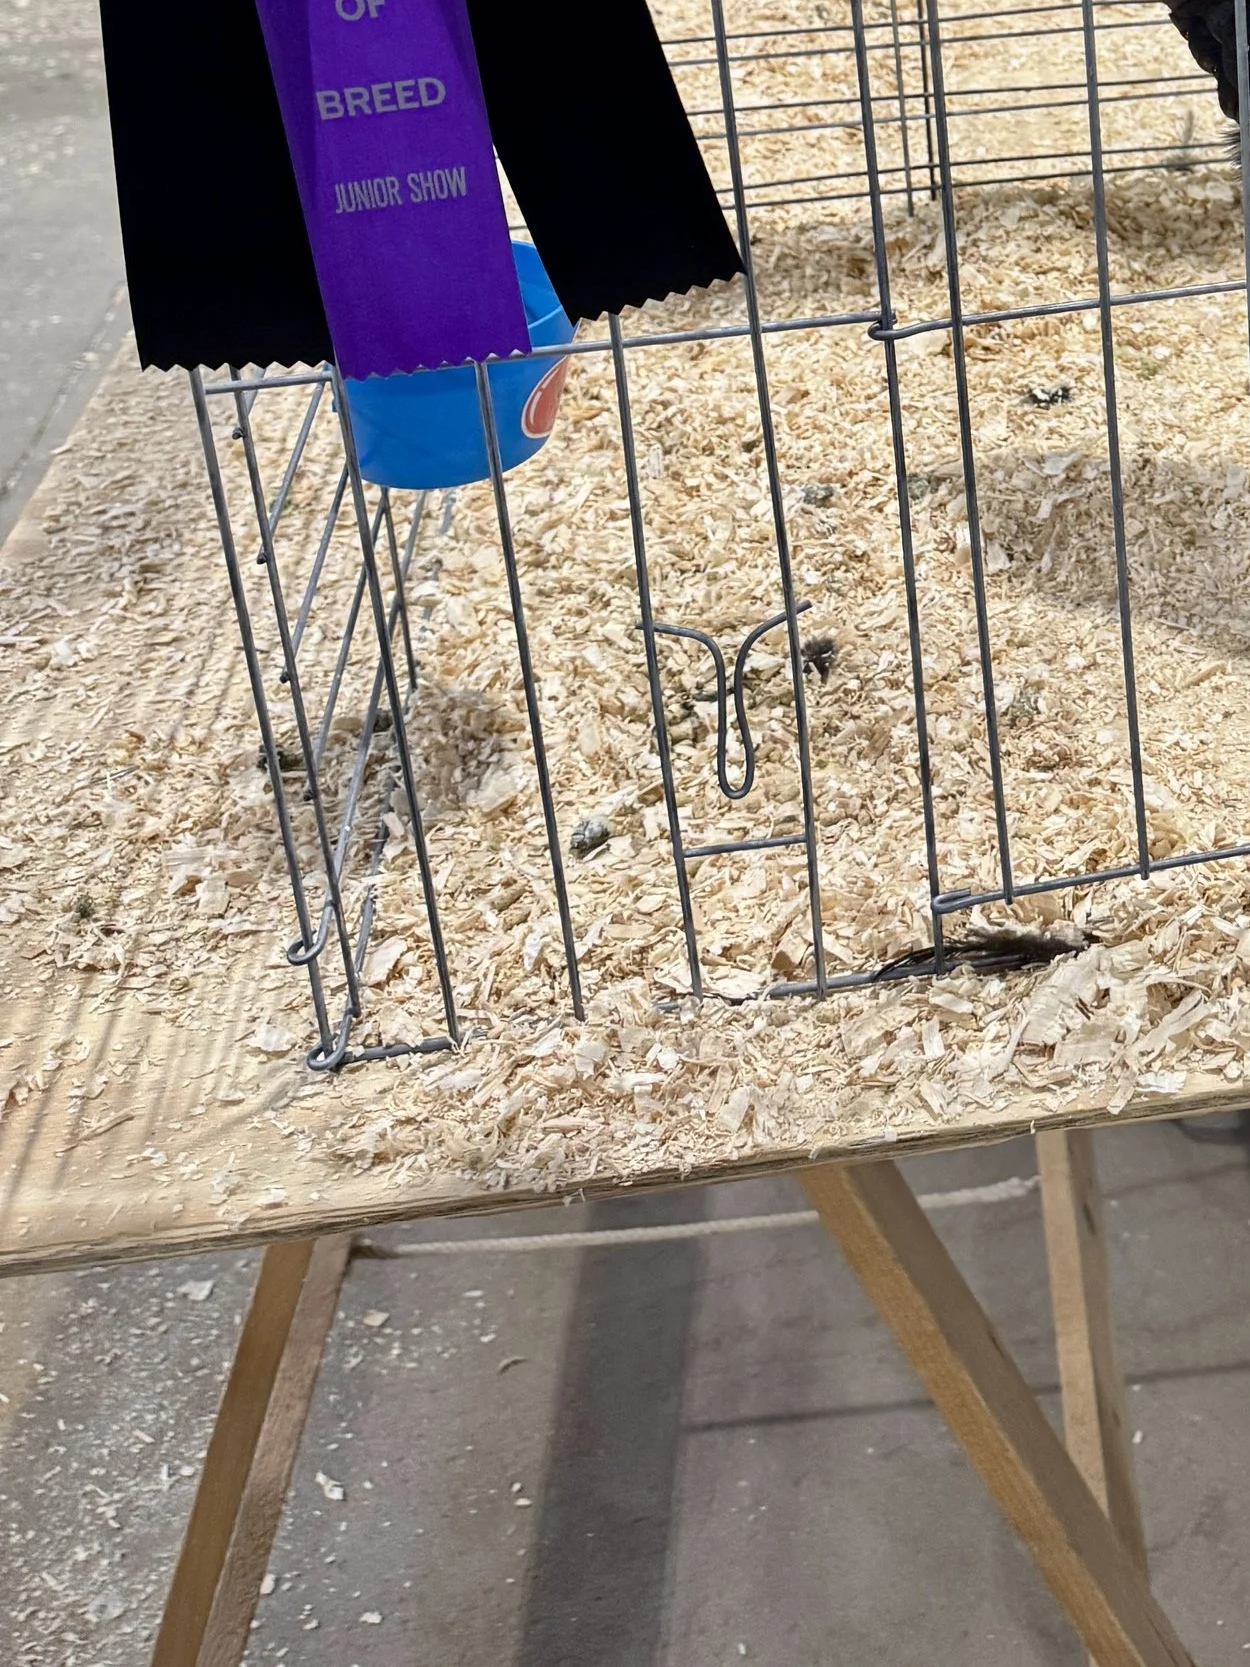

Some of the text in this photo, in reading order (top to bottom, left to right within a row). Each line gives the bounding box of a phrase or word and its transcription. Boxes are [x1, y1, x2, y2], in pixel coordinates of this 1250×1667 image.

[316, 77, 446, 121] BREED
[335, 166, 467, 214] JUNIOR SHOW
